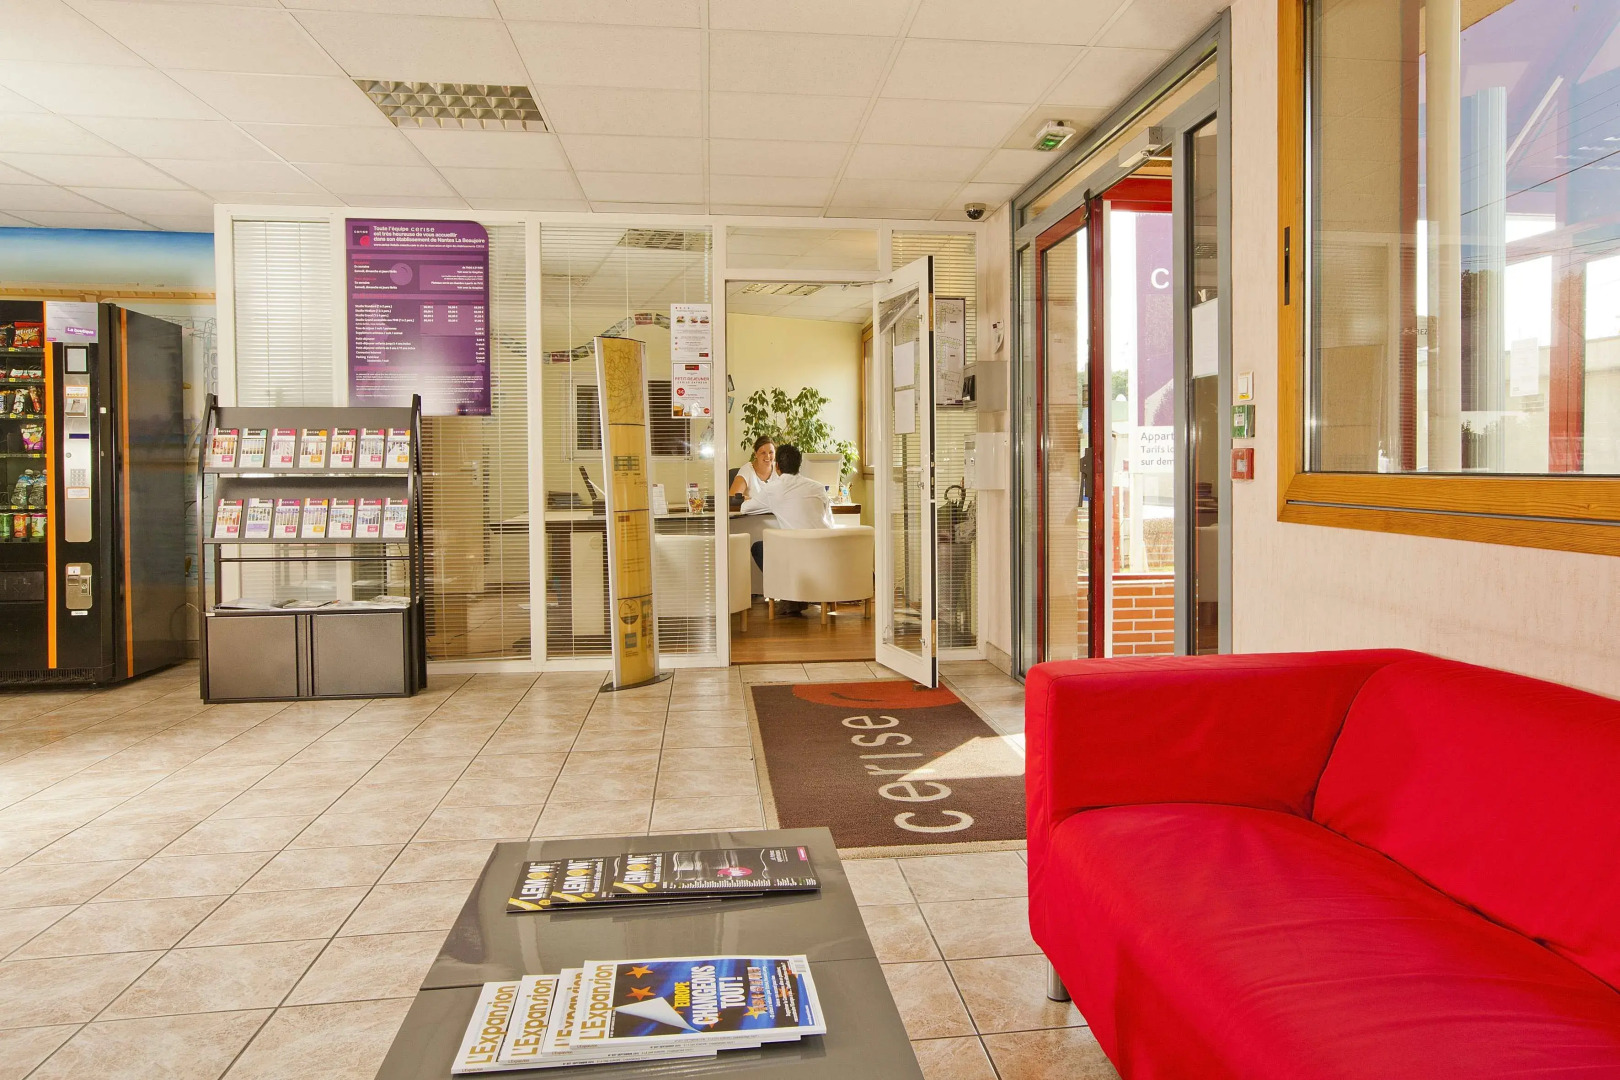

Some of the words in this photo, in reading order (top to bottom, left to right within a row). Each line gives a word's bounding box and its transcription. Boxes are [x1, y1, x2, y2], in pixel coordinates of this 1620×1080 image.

[842, 715, 974, 833] cerise
[465, 986, 517, 1065] L'Expansion
[509, 979, 554, 1057] L'Expansion
[578, 964, 615, 1040] L'Expansion
[674, 981, 691, 1007] EUROPE
[691, 965, 719, 1025] CHANGEONS
